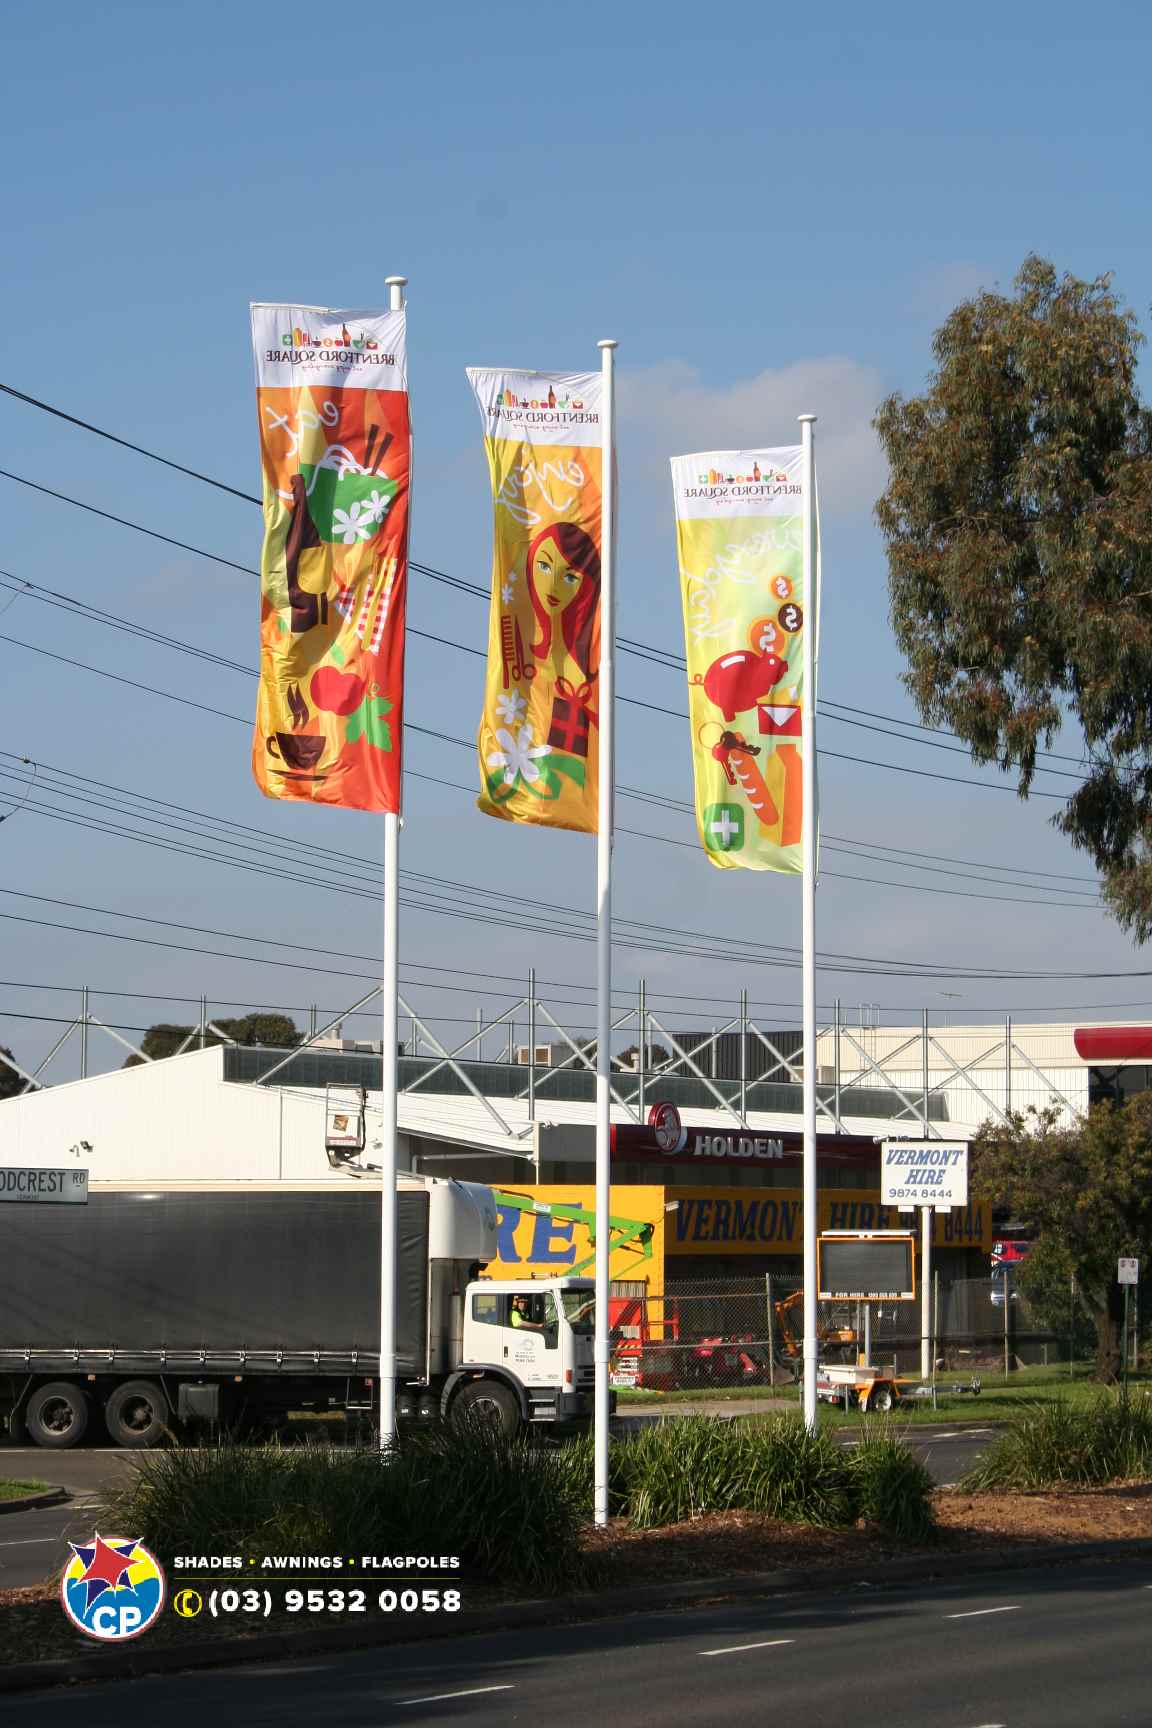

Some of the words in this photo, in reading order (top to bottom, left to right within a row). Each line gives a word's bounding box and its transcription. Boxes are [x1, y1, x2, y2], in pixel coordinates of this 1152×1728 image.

[693, 1135, 784, 1160] HOLDEN
[885, 1149, 964, 1167] VERMONT
[72, 1172, 86, 1185] RD
[904, 1168, 946, 1186] HIRE
[888, 1188, 917, 1199] 9874
[921, 1188, 953, 1199] 8444
